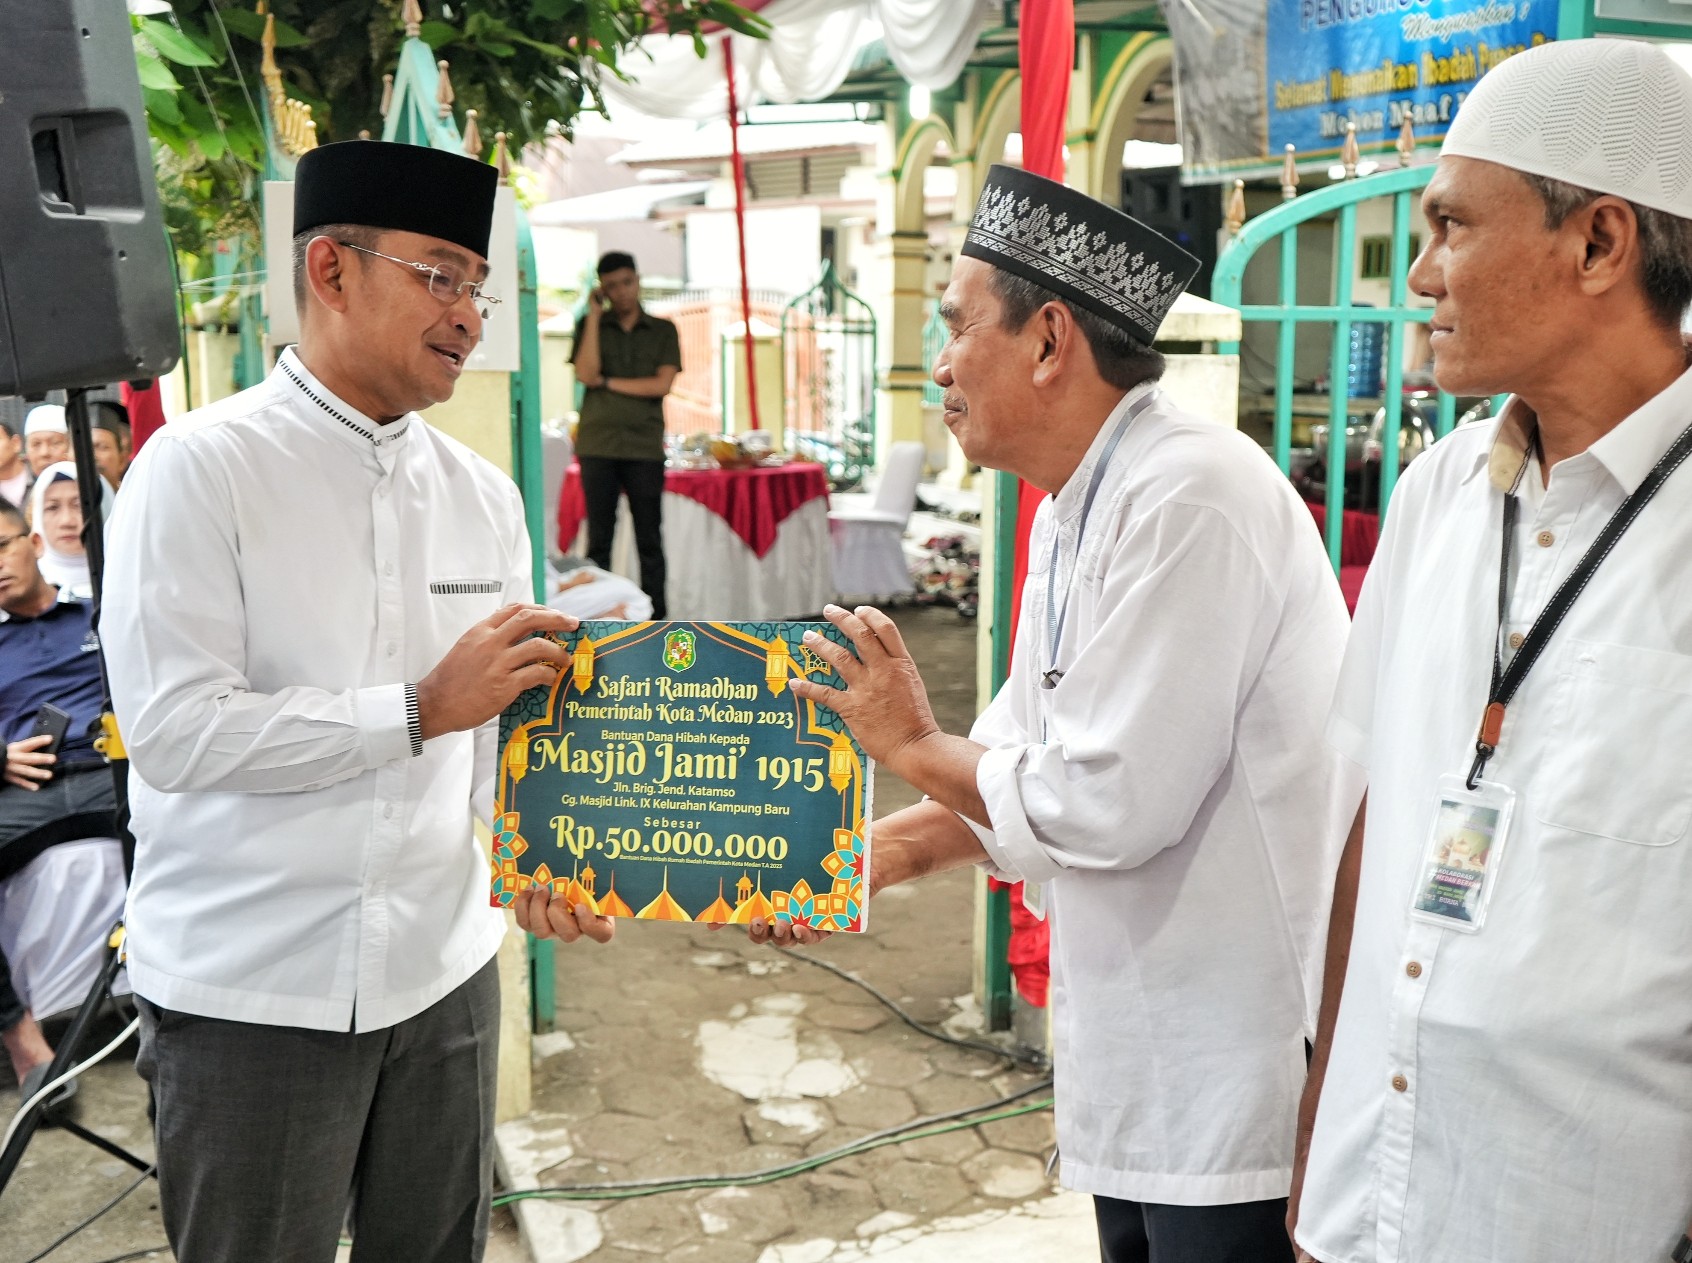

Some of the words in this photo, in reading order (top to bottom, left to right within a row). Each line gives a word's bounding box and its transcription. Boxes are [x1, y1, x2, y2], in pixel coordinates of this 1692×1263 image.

[1275, 78, 1327, 110] Selamat
[1330, 59, 1418, 99] Menunaikan
[1423, 46, 1477, 85] Ibadah
[597, 675, 651, 699] Safari
[655, 676, 758, 701] Ramadhan
[566, 701, 652, 722] Pemerintah
[656, 703, 695, 723] Kota
[698, 701, 754, 725] Medan
[757, 711, 794, 729] 2023
[601, 730, 644, 742] Bantuan
[646, 731, 673, 742] Dana
[675, 732, 707, 743] Hibah
[709, 734, 750, 746] Kepada
[531, 732, 647, 784] Masjid
[755, 755, 825, 792] 1915
[613, 782, 631, 793] Jln.
[633, 782, 657, 797] Brig.
[657, 784, 686, 796] Jend.
[688, 786, 735, 797] Katamso
[561, 794, 578, 807] Gg.
[580, 795, 613, 809] Masjid
[614, 796, 639, 808] Link.
[640, 798, 651, 809] IX
[653, 798, 707, 812] Kelurahan
[708, 801, 761, 816] Kampung
[764, 803, 790, 815] Baru
[644, 816, 702, 829] Sebesar
[549, 815, 788, 861] Rp.50.000.000
